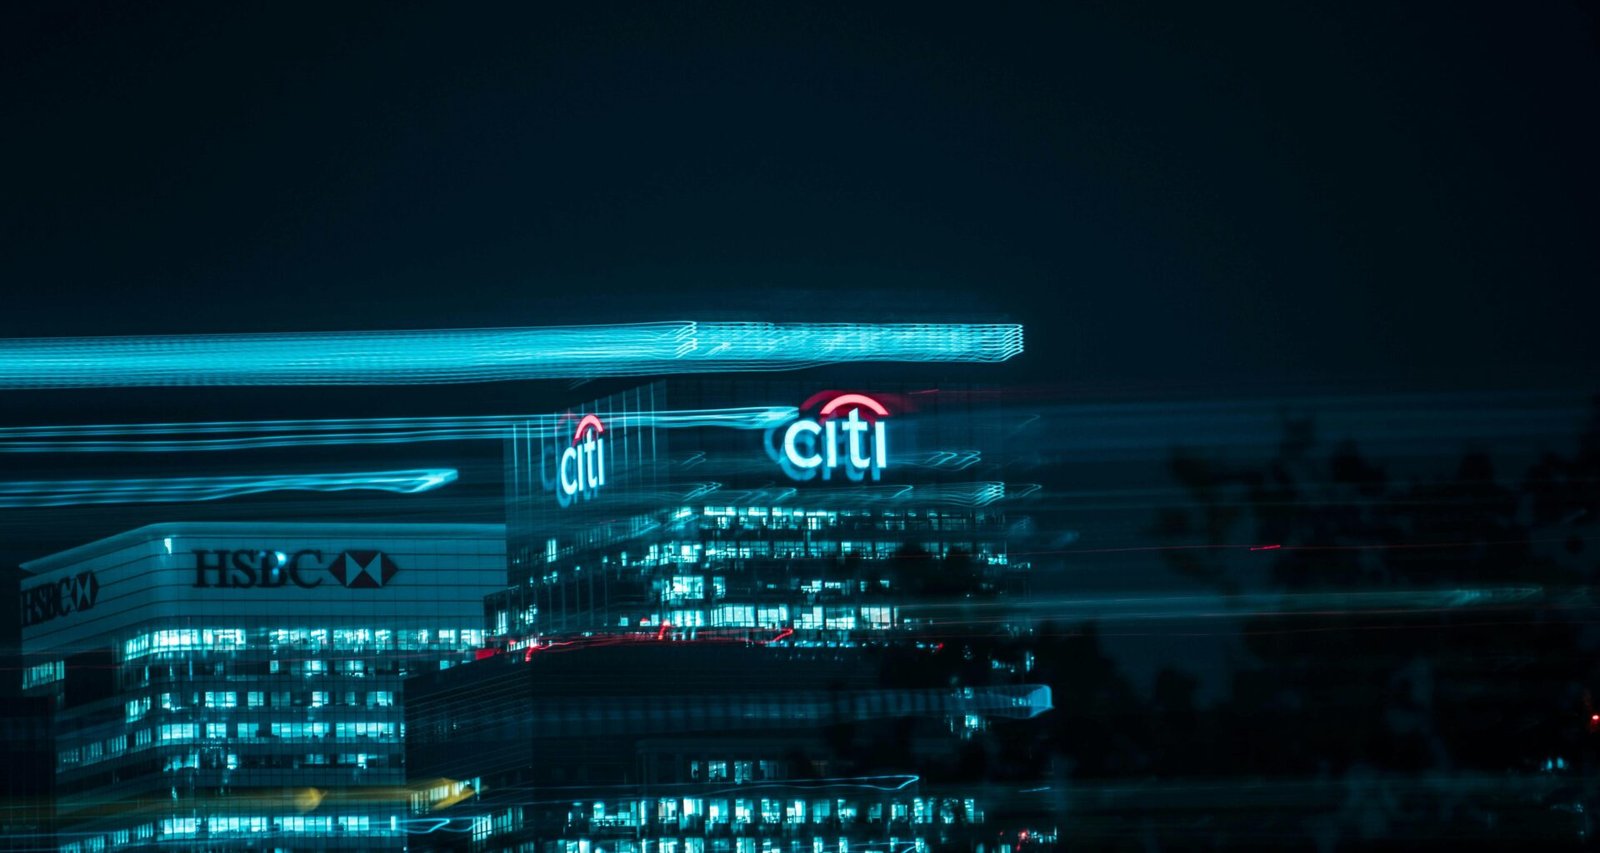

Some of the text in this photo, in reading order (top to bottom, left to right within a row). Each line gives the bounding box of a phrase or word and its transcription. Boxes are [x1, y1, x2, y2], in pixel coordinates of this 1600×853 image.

[559, 416, 606, 496] citi
[784, 396, 889, 469] citi
[191, 548, 324, 589] HSBC
